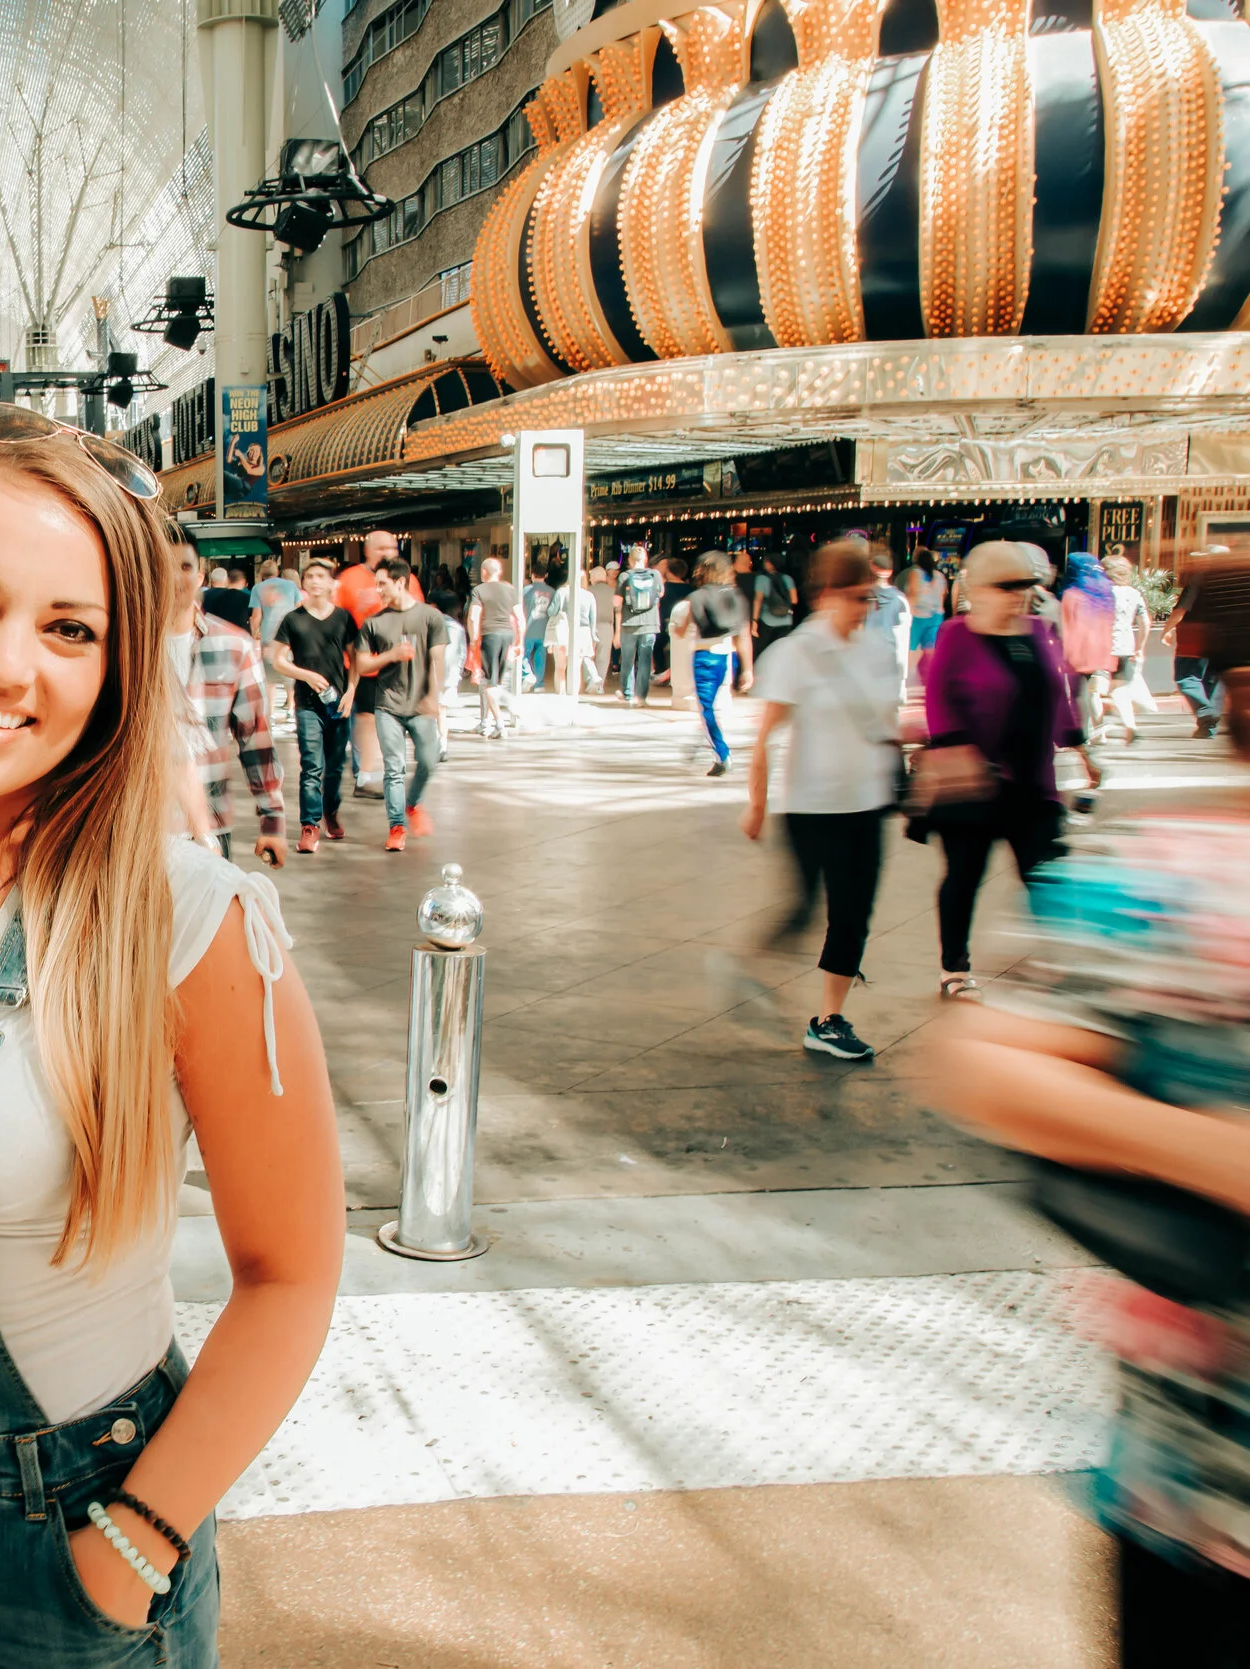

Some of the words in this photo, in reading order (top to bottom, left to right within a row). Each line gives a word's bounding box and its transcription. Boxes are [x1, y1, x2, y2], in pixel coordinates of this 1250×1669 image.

[266, 291, 347, 424] ASINO
[230, 398, 259, 409] NEON
[231, 409, 258, 421] HIGH
[230, 420, 259, 433] CLUB
[591, 484, 609, 497] Prime
[611, 481, 623, 495] Rib
[623, 480, 647, 494] Dinner
[649, 474, 676, 492] $14.99
[1103, 508, 1140, 525] FREE
[1102, 524, 1140, 541] PULL
